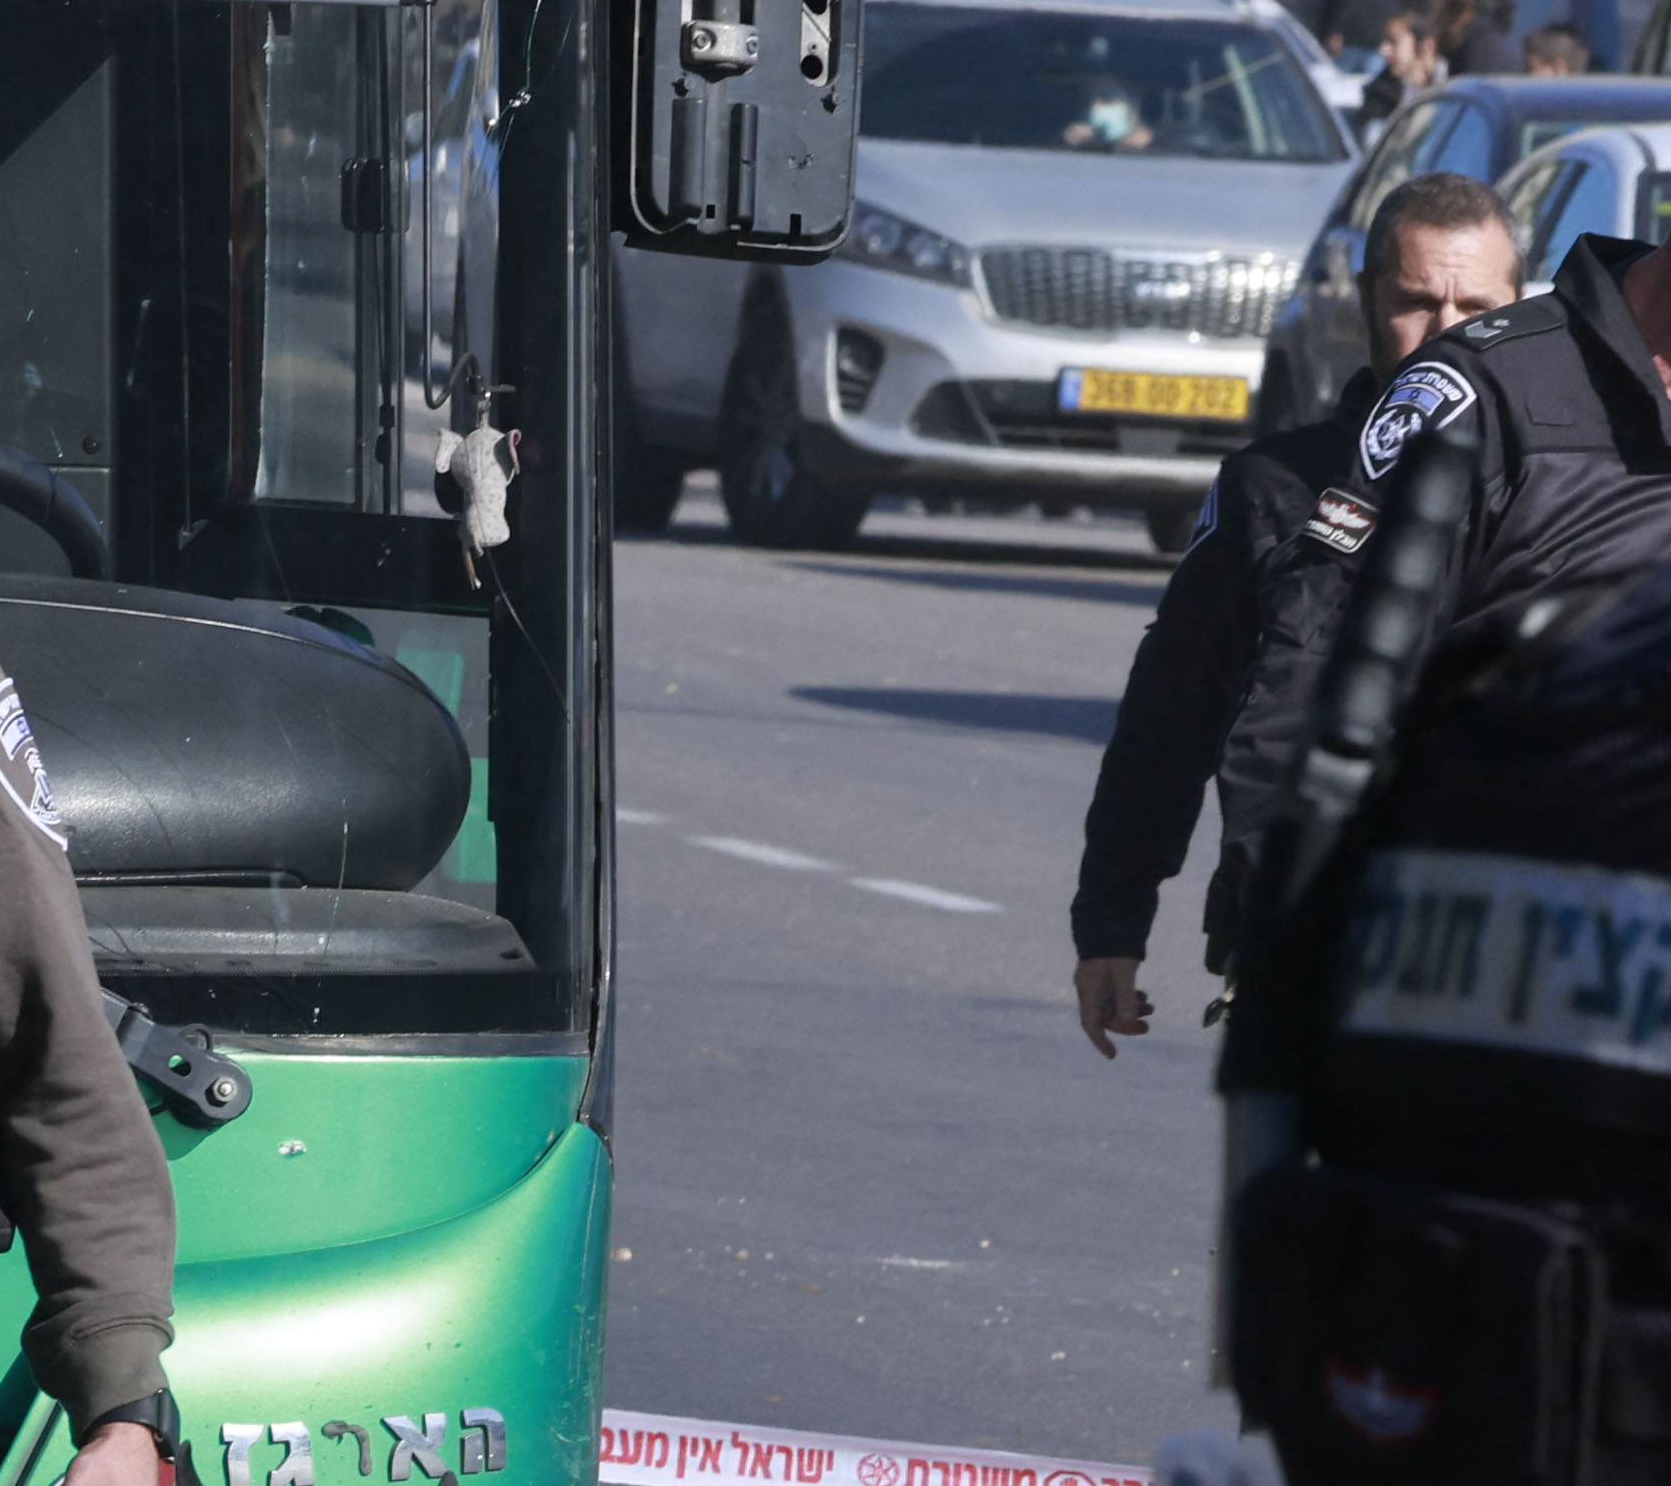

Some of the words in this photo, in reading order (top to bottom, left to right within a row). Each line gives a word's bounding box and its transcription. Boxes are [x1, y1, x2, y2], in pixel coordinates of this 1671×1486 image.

[598, 1425, 670, 1470] מעב
[675, 1434, 724, 1480] אין
[731, 1430, 836, 1484] ישראל
